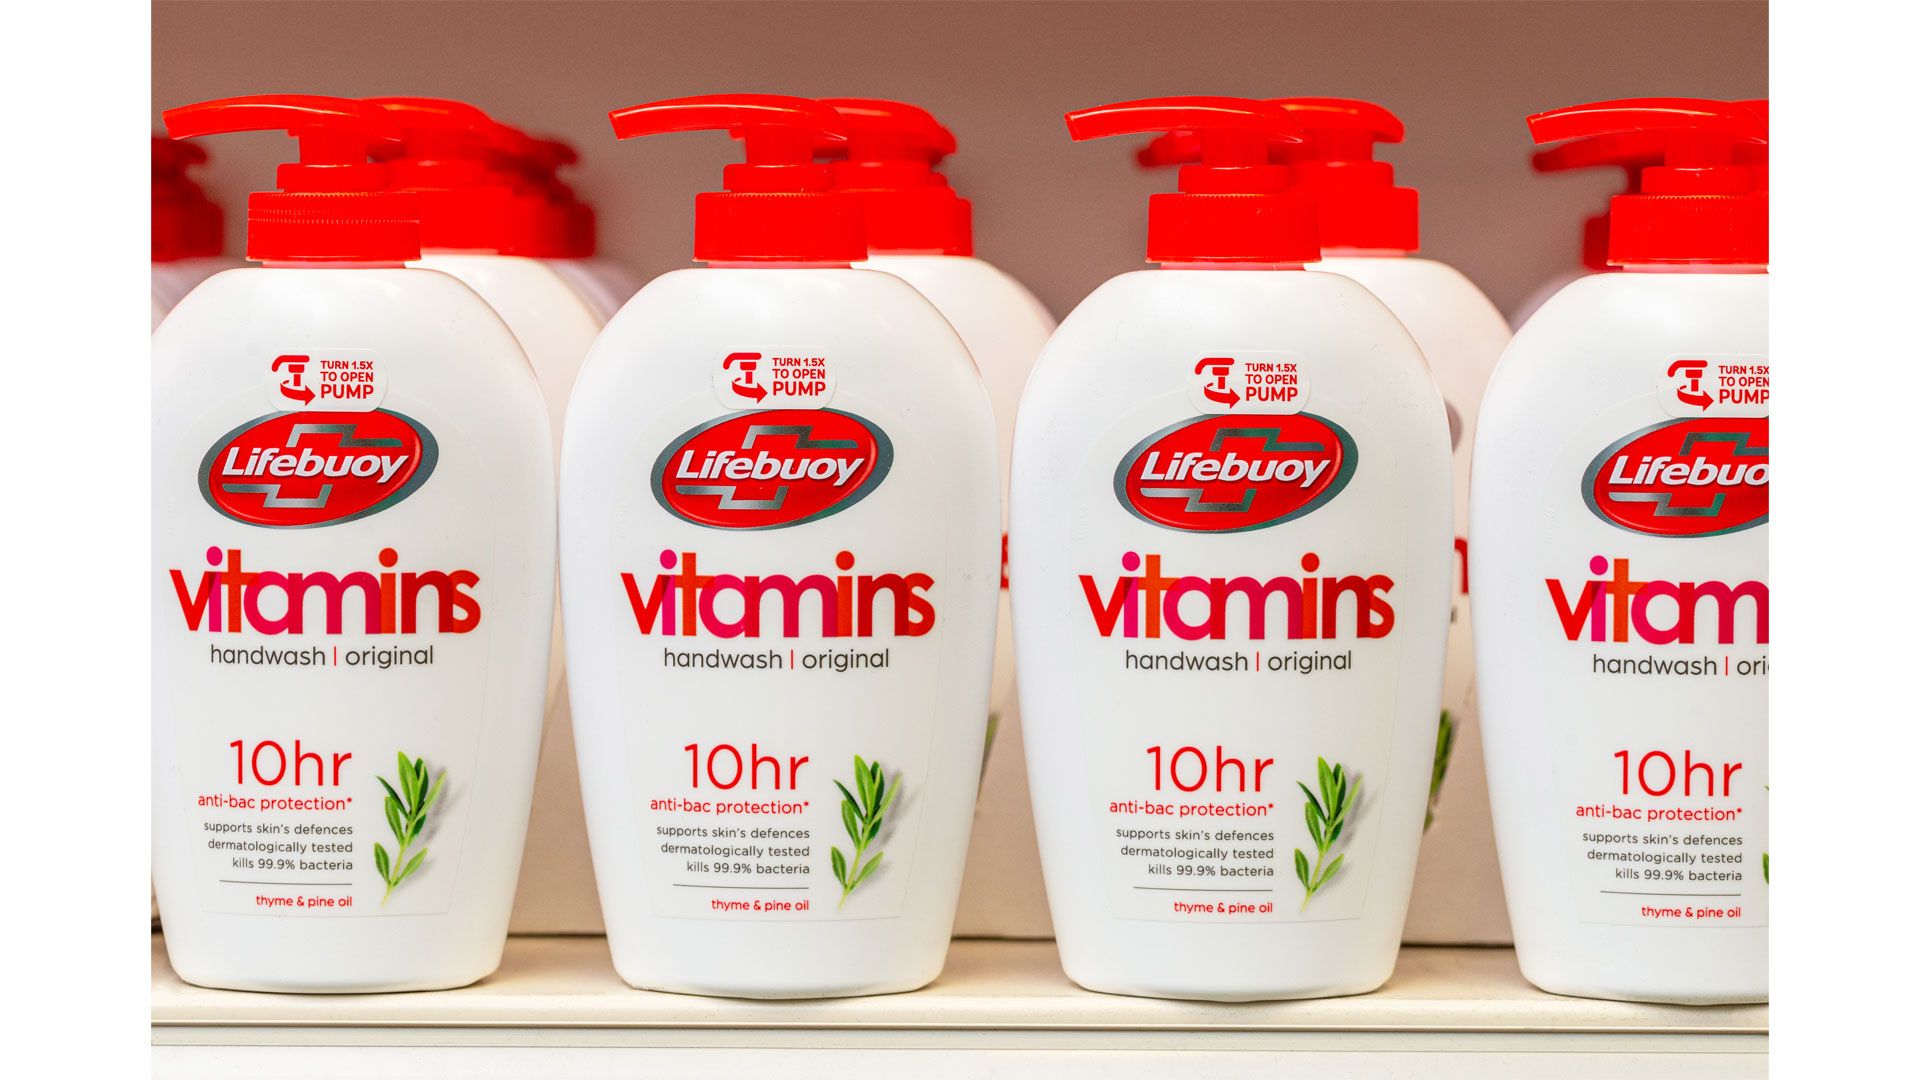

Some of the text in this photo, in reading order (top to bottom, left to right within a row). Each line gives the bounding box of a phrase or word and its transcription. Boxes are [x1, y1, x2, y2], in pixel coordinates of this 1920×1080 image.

[320, 360, 373, 370] TURN 1.5X
[772, 358, 825, 367] TURN 1.5X
[1245, 363, 1297, 372] TURN 1.5X
[1718, 365, 1768, 374] TURN 1.5X
[320, 371, 373, 382] TO OPEN
[772, 369, 825, 379] TO OPEN
[1245, 374, 1297, 385] TO OPEN
[1718, 376, 1768, 387] TO OPEN
[321, 384, 374, 399] PUMP
[773, 381, 826, 396] PUMP
[1246, 386, 1298, 402] PUMP
[1719, 389, 1768, 404] PUMP
[222, 446, 409, 483] Lifebuoy
[676, 450, 864, 486] Lifebuoy
[1140, 451, 1331, 487] Lifebuoy
[169, 546, 481, 635] vitamins
[620, 549, 935, 639] vitamins
[1079, 551, 1395, 641] vitamins
[211, 644, 433, 669] handwash original
[665, 648, 888, 672] handwash original
[1126, 650, 1351, 674] handwash original
[1594, 654, 1768, 675] handwash ori
[230, 740, 352, 786] 10hr
[685, 743, 809, 790] 10hr
[1147, 745, 1274, 792] 10hr
[1614, 750, 1742, 796] 10hr
[198, 794, 255, 809] anti-bac
[651, 798, 710, 812] anti-bac
[1110, 800, 1174, 815] anti-bac
[1576, 804, 1641, 819] anti-bac
[204, 823, 252, 833] supports
[294, 824, 353, 835] defences
[657, 827, 707, 837] supports
[751, 828, 809, 838] defences
[1116, 829, 1170, 840] supports
[1215, 830, 1274, 841] defences
[208, 838, 352, 854] dermatologically tested
[1583, 833, 1638, 844] supports
[1683, 835, 1742, 845] defences
[661, 843, 809, 858] dermatologically tested
[1121, 845, 1273, 860] dermatologically tested
[1587, 849, 1742, 865] dermatologically tested
[233, 858, 353, 870] kills 99.9% bacteria
[687, 862, 809, 874] kills 99.9% bacteria
[1149, 864, 1273, 876] kills 99.9% bacteria
[1616, 868, 1742, 881] kills 99.9% bacteria
[256, 896, 352, 908] thyme & pine oil
[712, 900, 809, 912] thyme & pine oil
[1174, 902, 1272, 914] thyme & pine oil
[1642, 906, 1741, 919] thyme & pine oil
